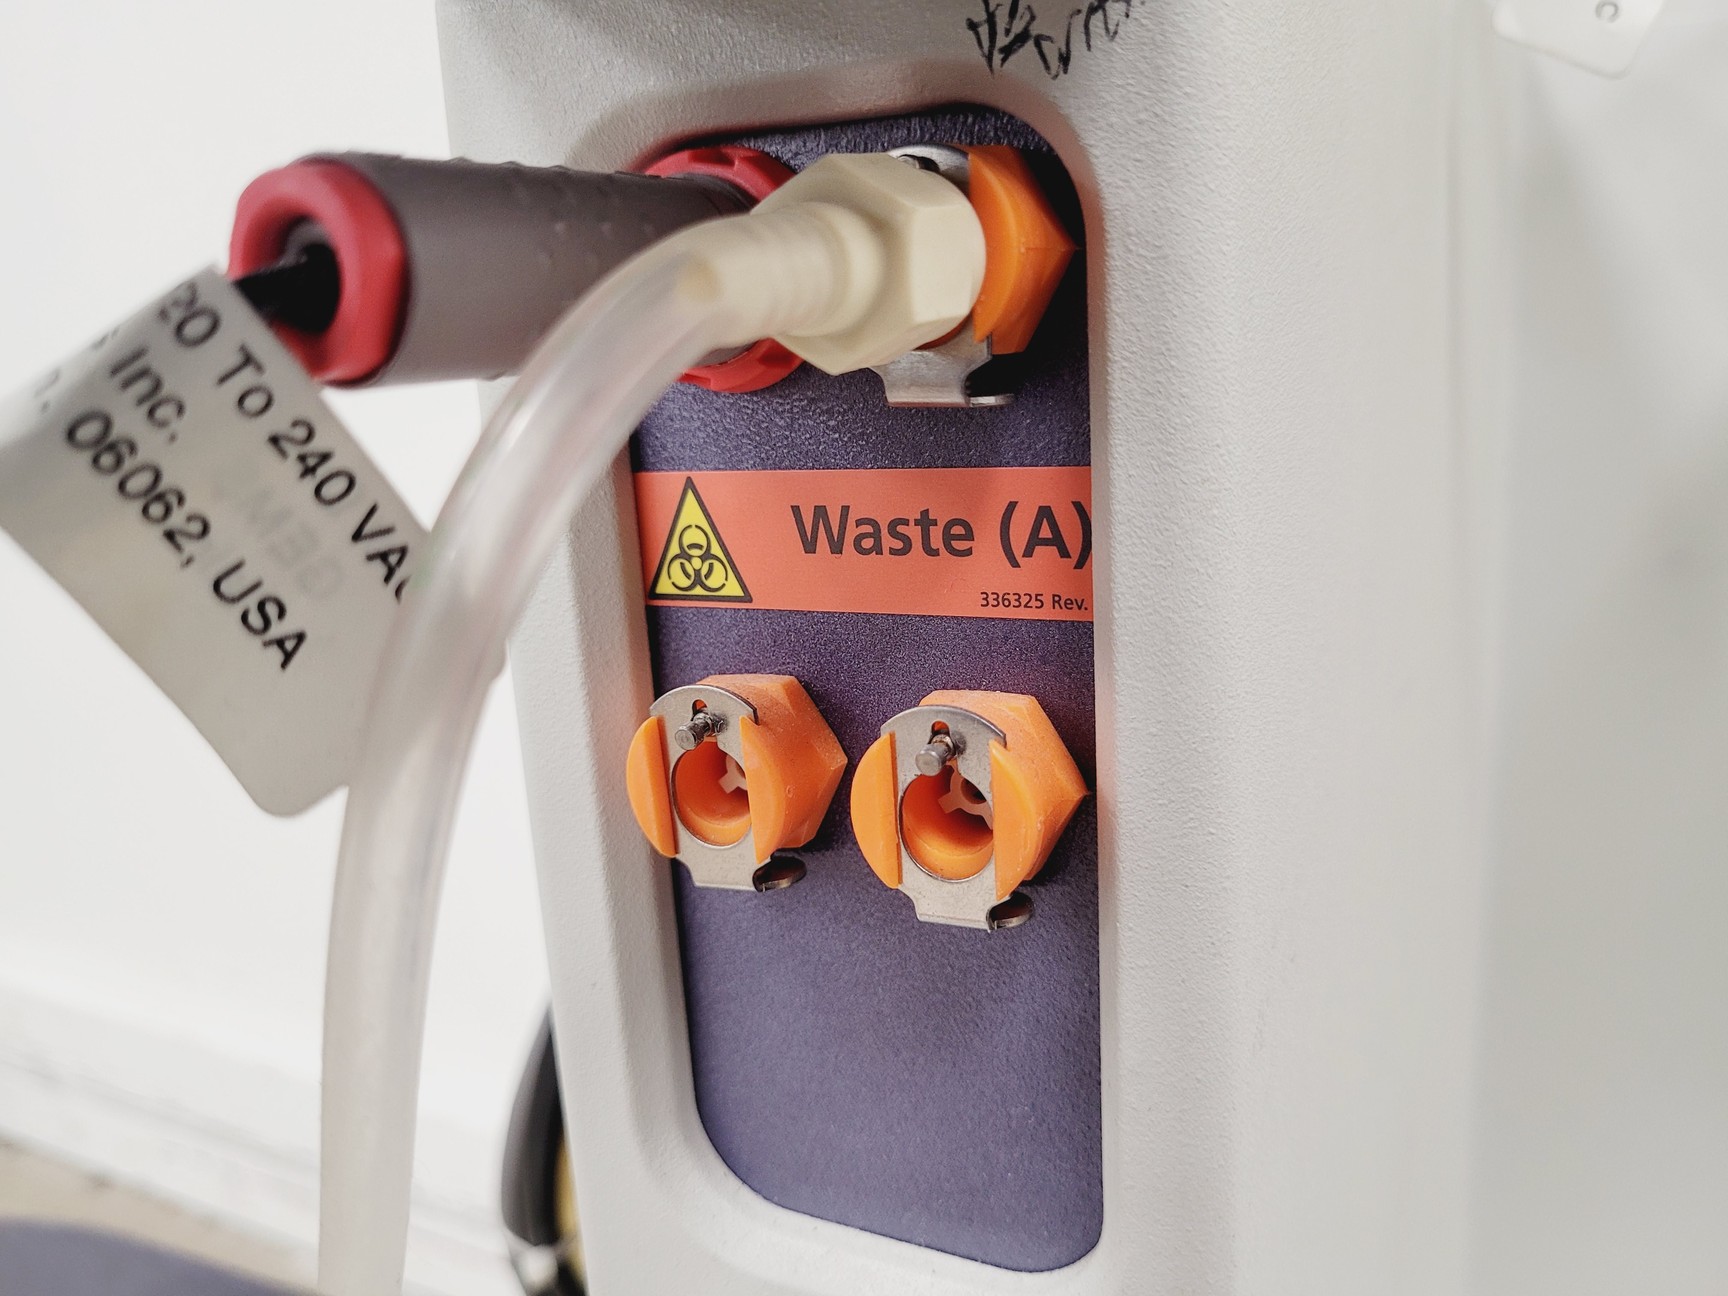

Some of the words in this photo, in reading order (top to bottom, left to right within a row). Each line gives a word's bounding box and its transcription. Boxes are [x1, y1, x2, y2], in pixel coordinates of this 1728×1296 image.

[109, 347, 187, 443] Inc.
[216, 344, 274, 419] To
[267, 418, 357, 506] 240
[66, 410, 211, 568] 06062,
[212, 559, 308, 669] USA
[790, 504, 975, 557] Waste
[999, 501, 1091, 569] (A)
[979, 592, 1044, 610] 336325
[1051, 594, 1089, 611] Rev.
